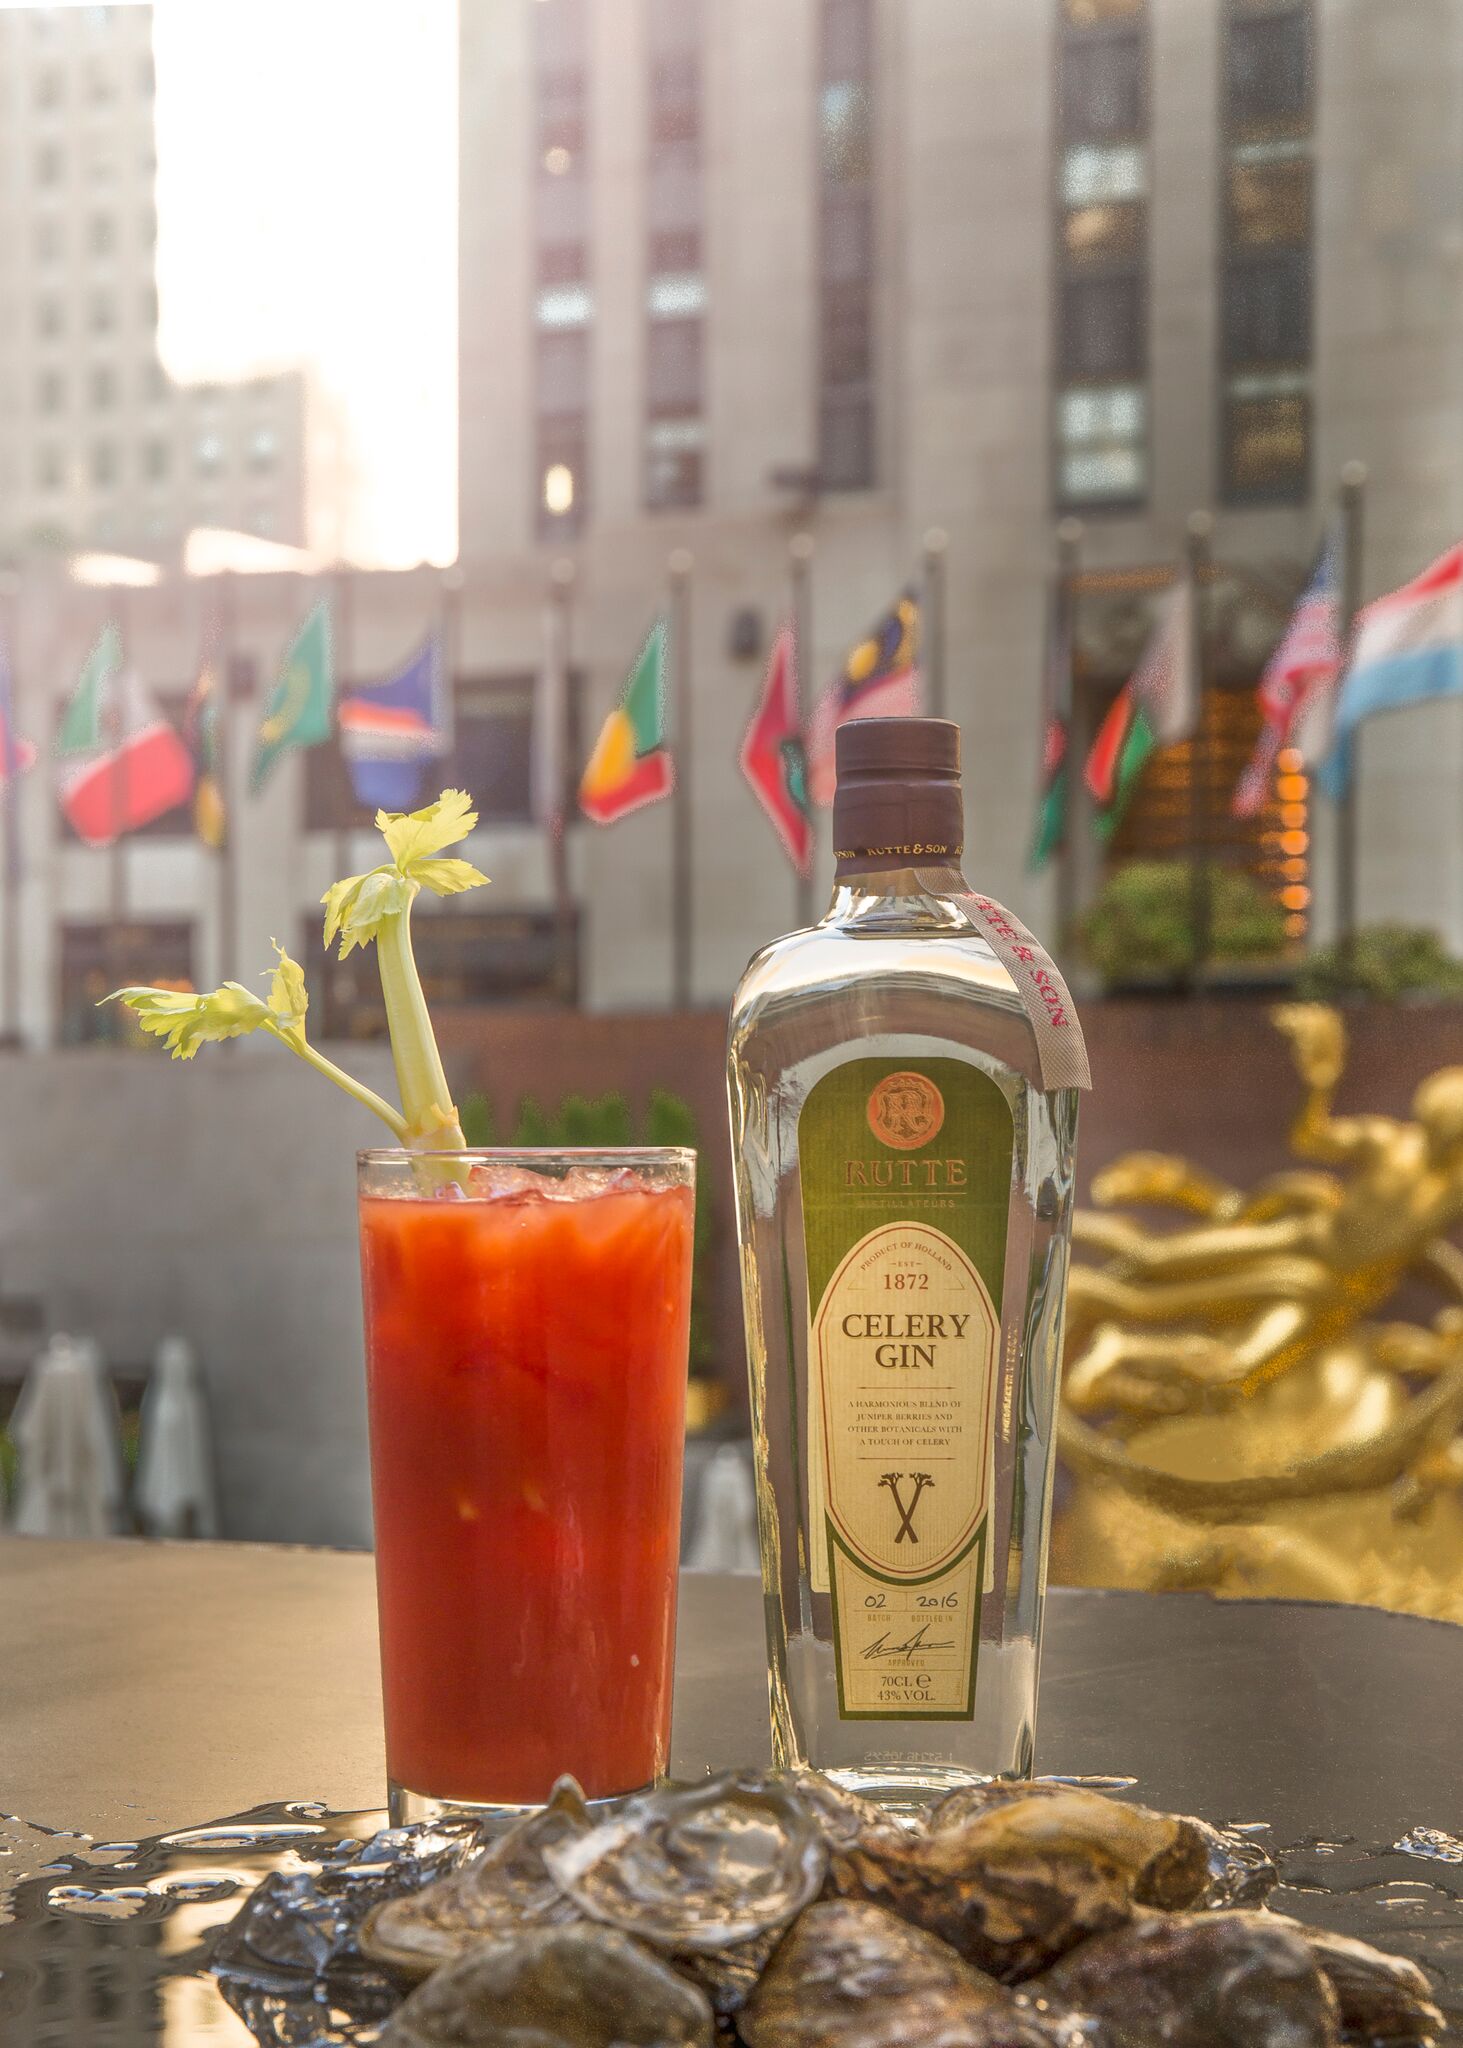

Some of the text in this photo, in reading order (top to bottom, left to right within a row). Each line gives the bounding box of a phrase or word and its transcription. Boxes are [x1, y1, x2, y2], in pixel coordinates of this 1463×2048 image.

[1029, 967, 1069, 1027] SON
[844, 1159, 969, 1187] RUTTE
[860, 1241, 953, 1272] PRODUCT OF HOLLAND
[883, 1273, 929, 1290] 1872
[841, 1313, 971, 1339] CELERY
[875, 1344, 937, 1369] GIN
[848, 1400, 855, 1408] A
[856, 1400, 918, 1408] HARMONIOUS
[856, 1413, 953, 1421] JUNIPER BERRIES AND
[847, 1425, 963, 1433] OTHER BOTANICALS WITH
[859, 1438, 951, 1446] A TOUCH OF CELERY
[864, 1591, 959, 1609] 02 2016
[881, 1675, 913, 1688] 70CL
[877, 1690, 902, 1701] 43%
